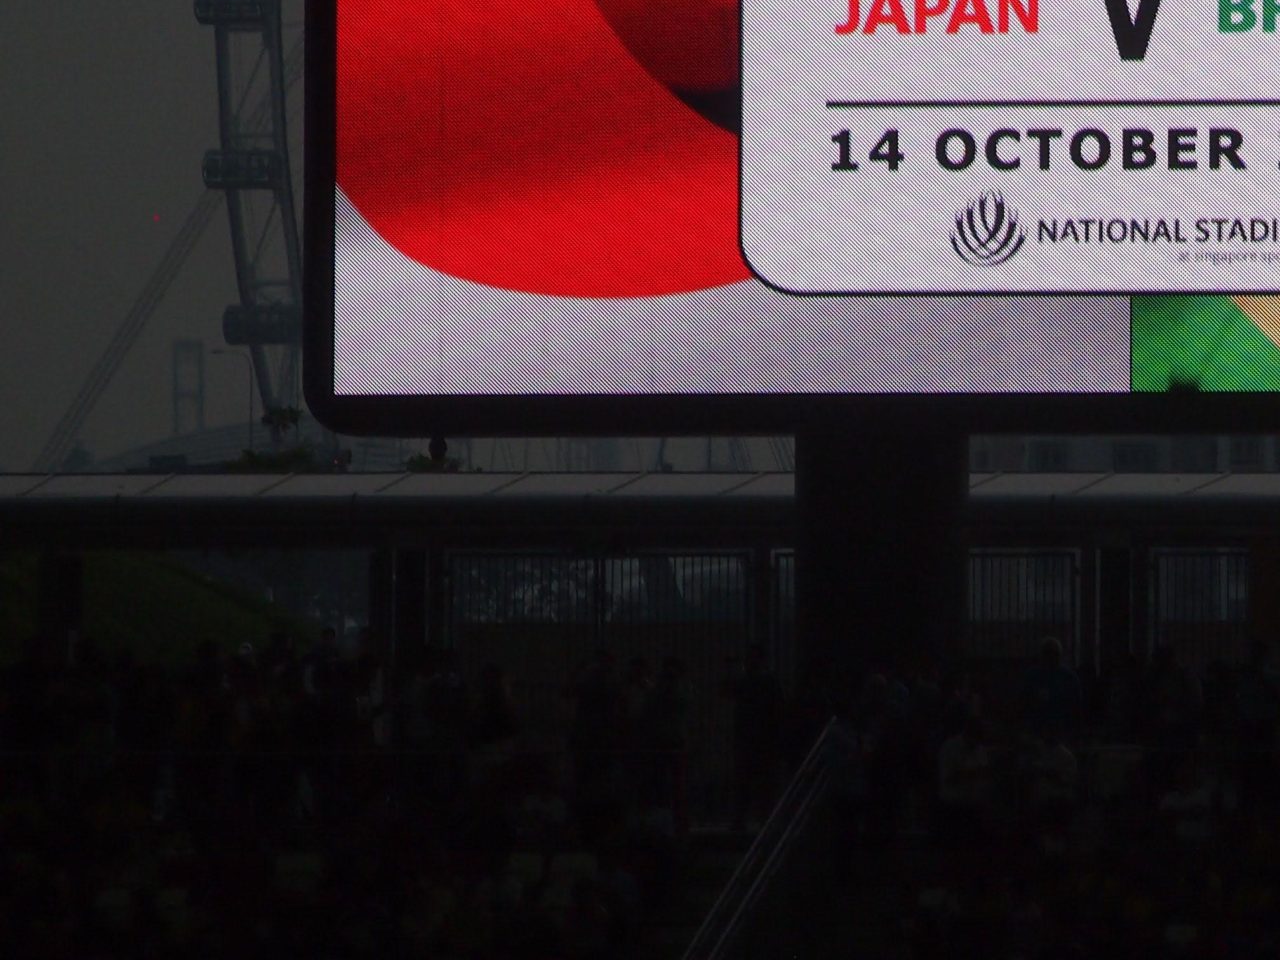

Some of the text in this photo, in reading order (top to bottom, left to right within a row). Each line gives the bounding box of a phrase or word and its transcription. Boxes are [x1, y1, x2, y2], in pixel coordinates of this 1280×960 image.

[831, 129, 903, 171] 14
[935, 128, 1246, 171] OCTOBER
[1037, 219, 1187, 244] NATIONAL
[1194, 249, 1257, 265] singapore
